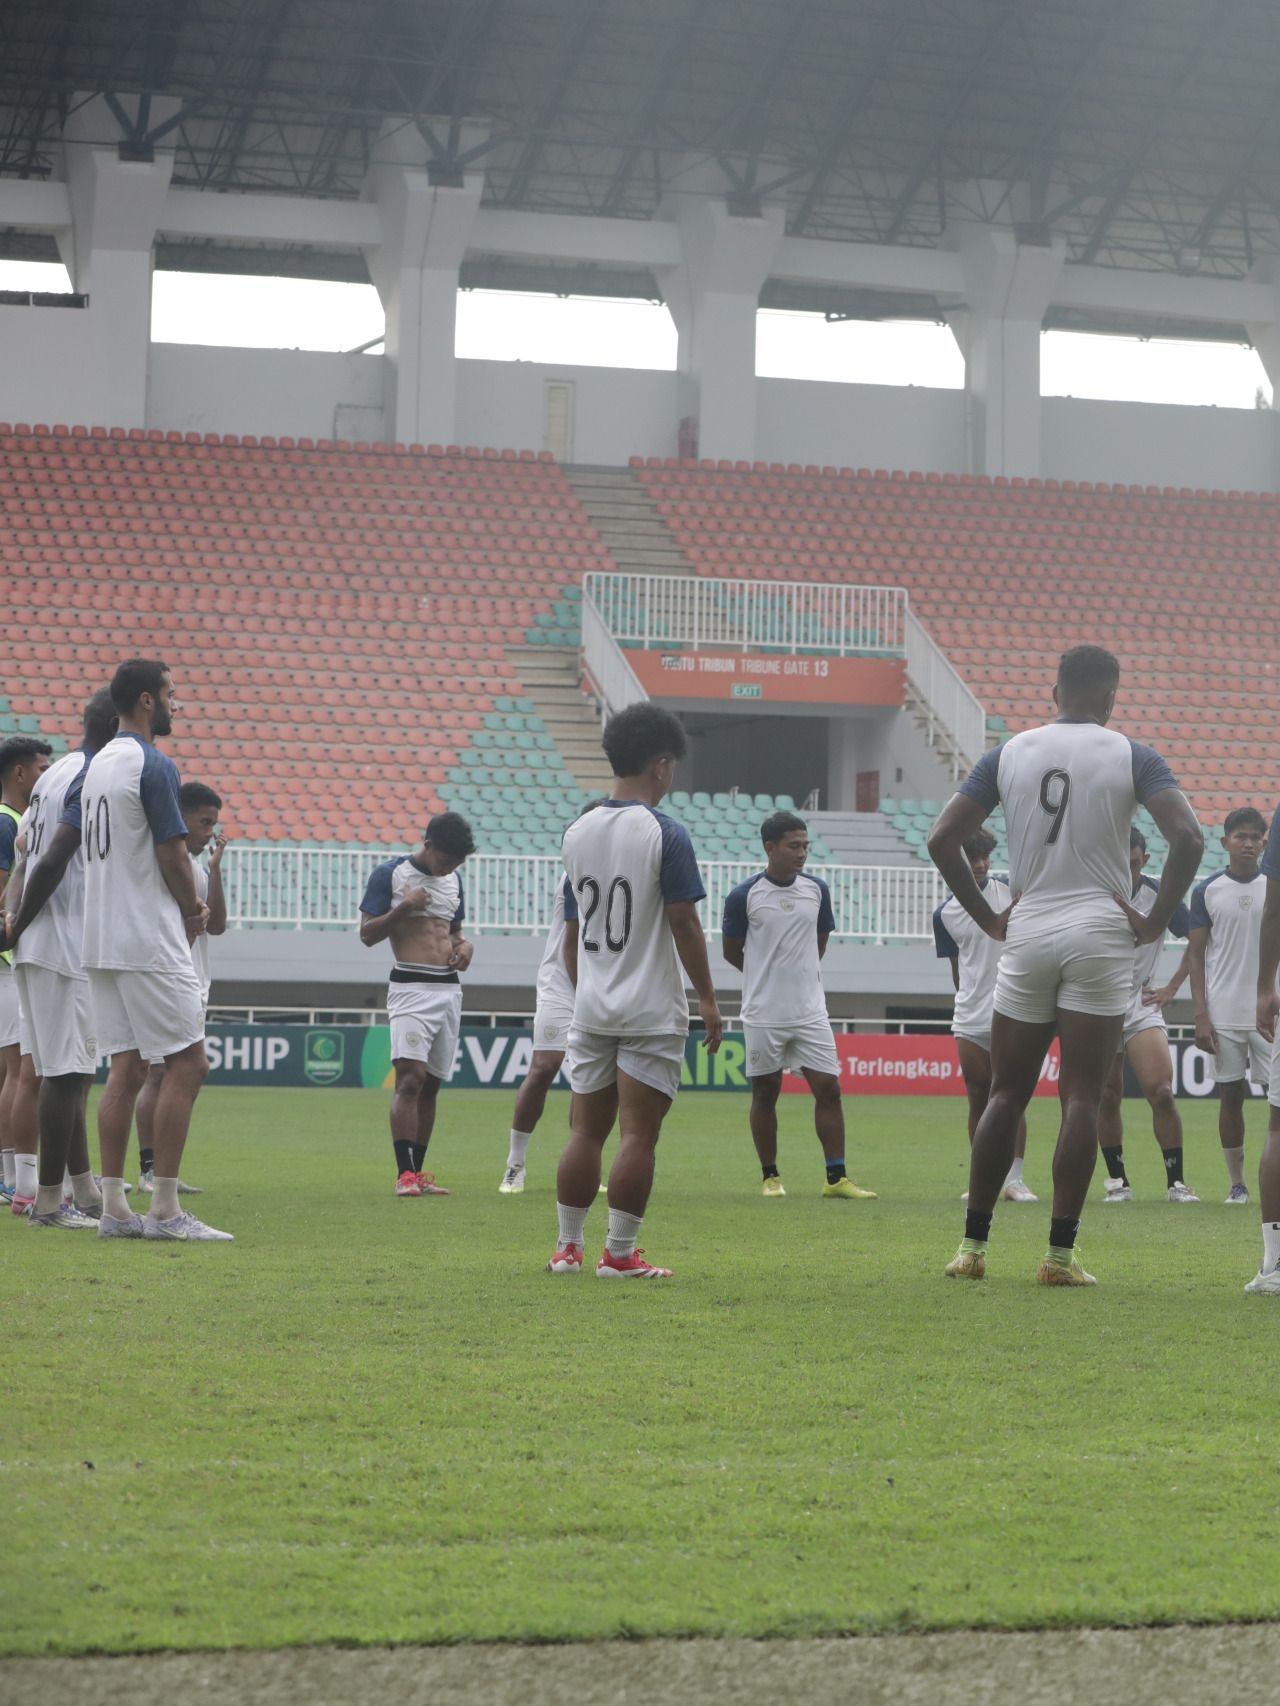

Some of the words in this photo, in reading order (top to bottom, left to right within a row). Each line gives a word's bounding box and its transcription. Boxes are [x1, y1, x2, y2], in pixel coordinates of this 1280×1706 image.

[698, 657, 735, 673] TRIBUN
[741, 658, 780, 675] TRIBUNE
[784, 661, 809, 676] GATE
[814, 660, 829, 677] 13
[733, 685, 760, 697] EXIT
[1039, 767, 1072, 847] 9
[577, 875, 632, 954] 20
[848, 1057, 951, 1079] Terlengkap
